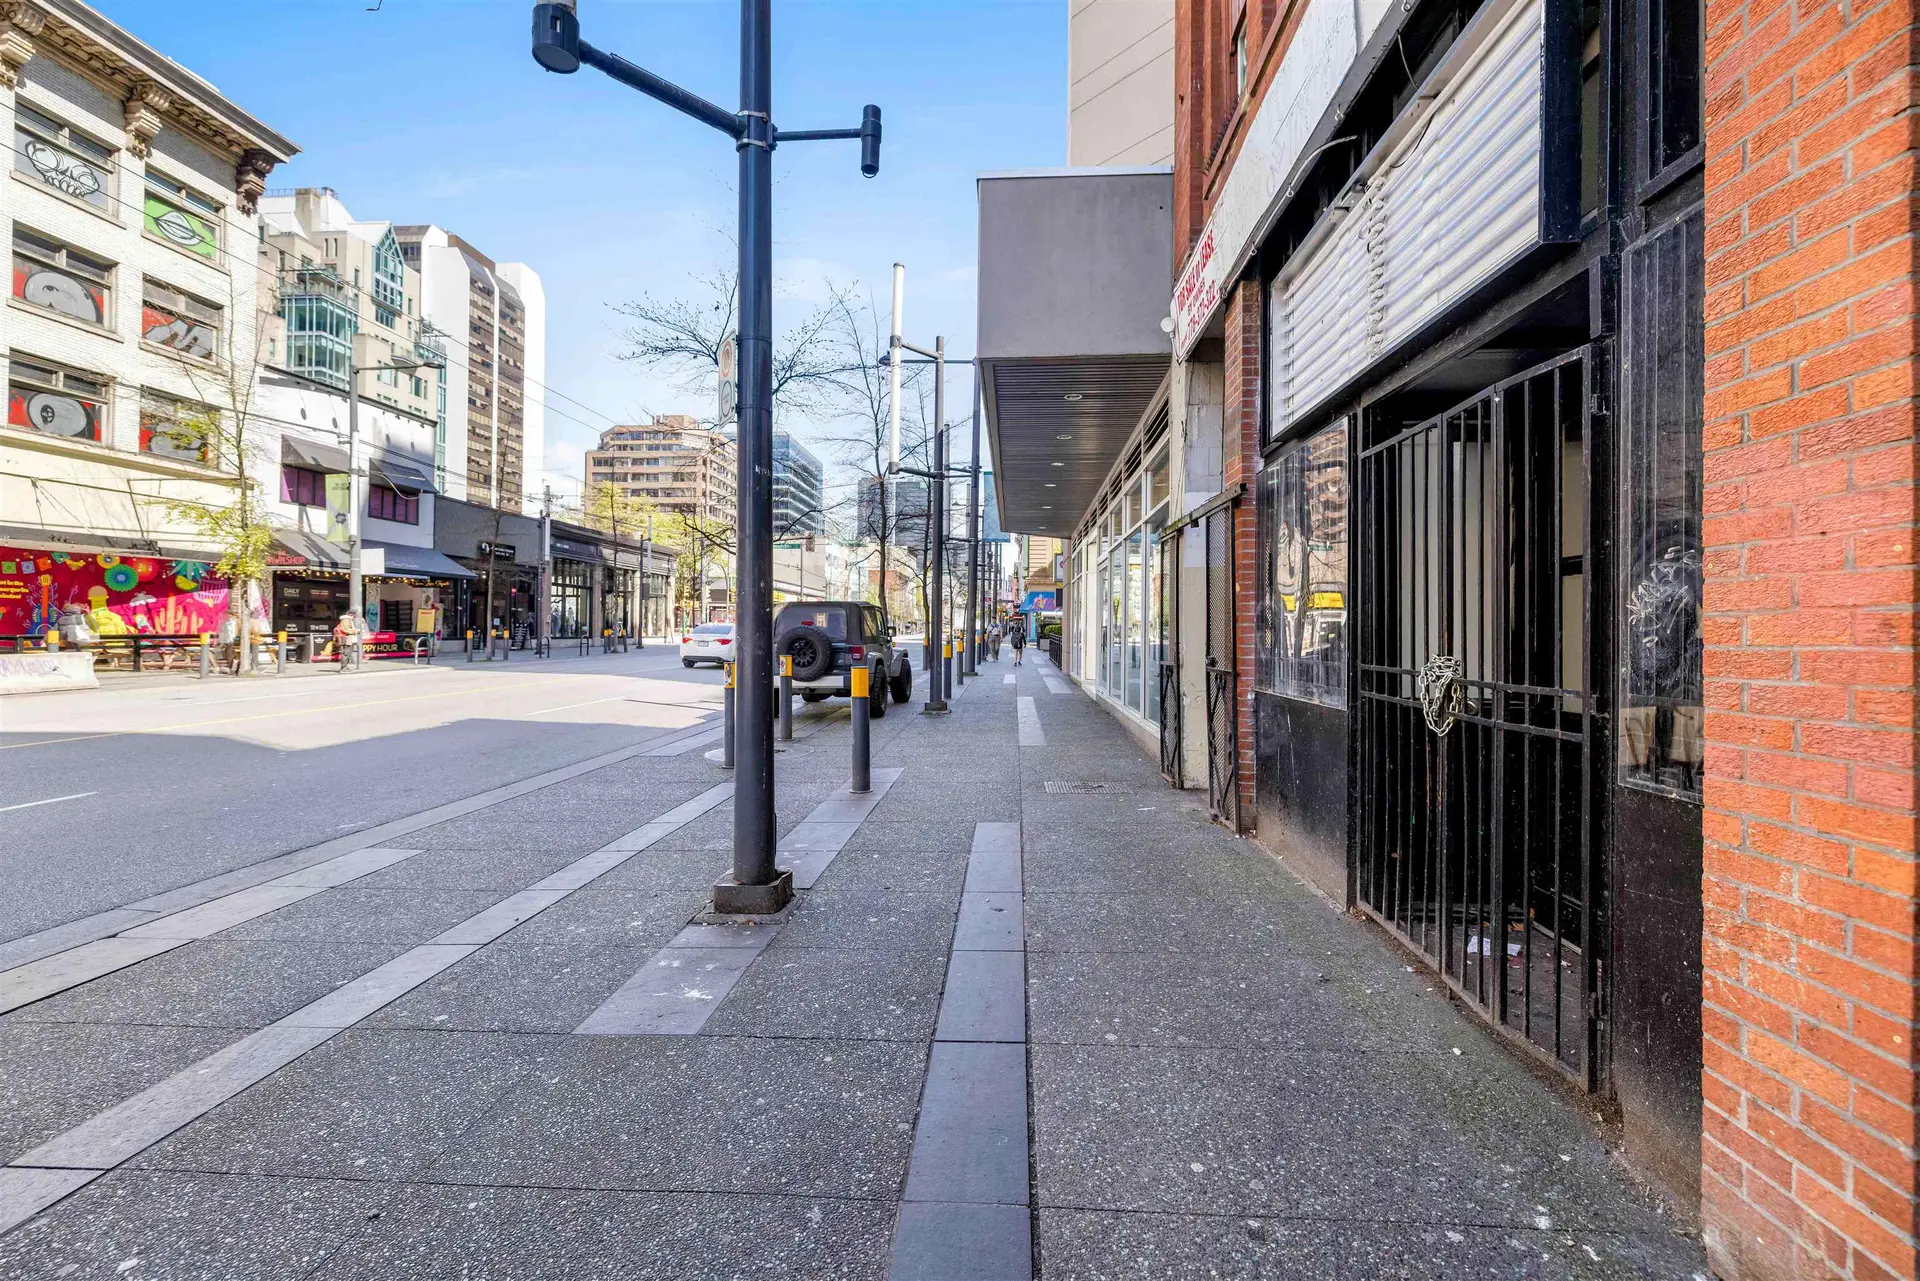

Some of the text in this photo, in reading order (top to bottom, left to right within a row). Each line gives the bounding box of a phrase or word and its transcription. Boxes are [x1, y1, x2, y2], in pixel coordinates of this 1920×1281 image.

[1185, 266, 1196, 301] SALE
[1200, 228, 1214, 272] LEASE
[377, 643, 398, 652] HOUR
